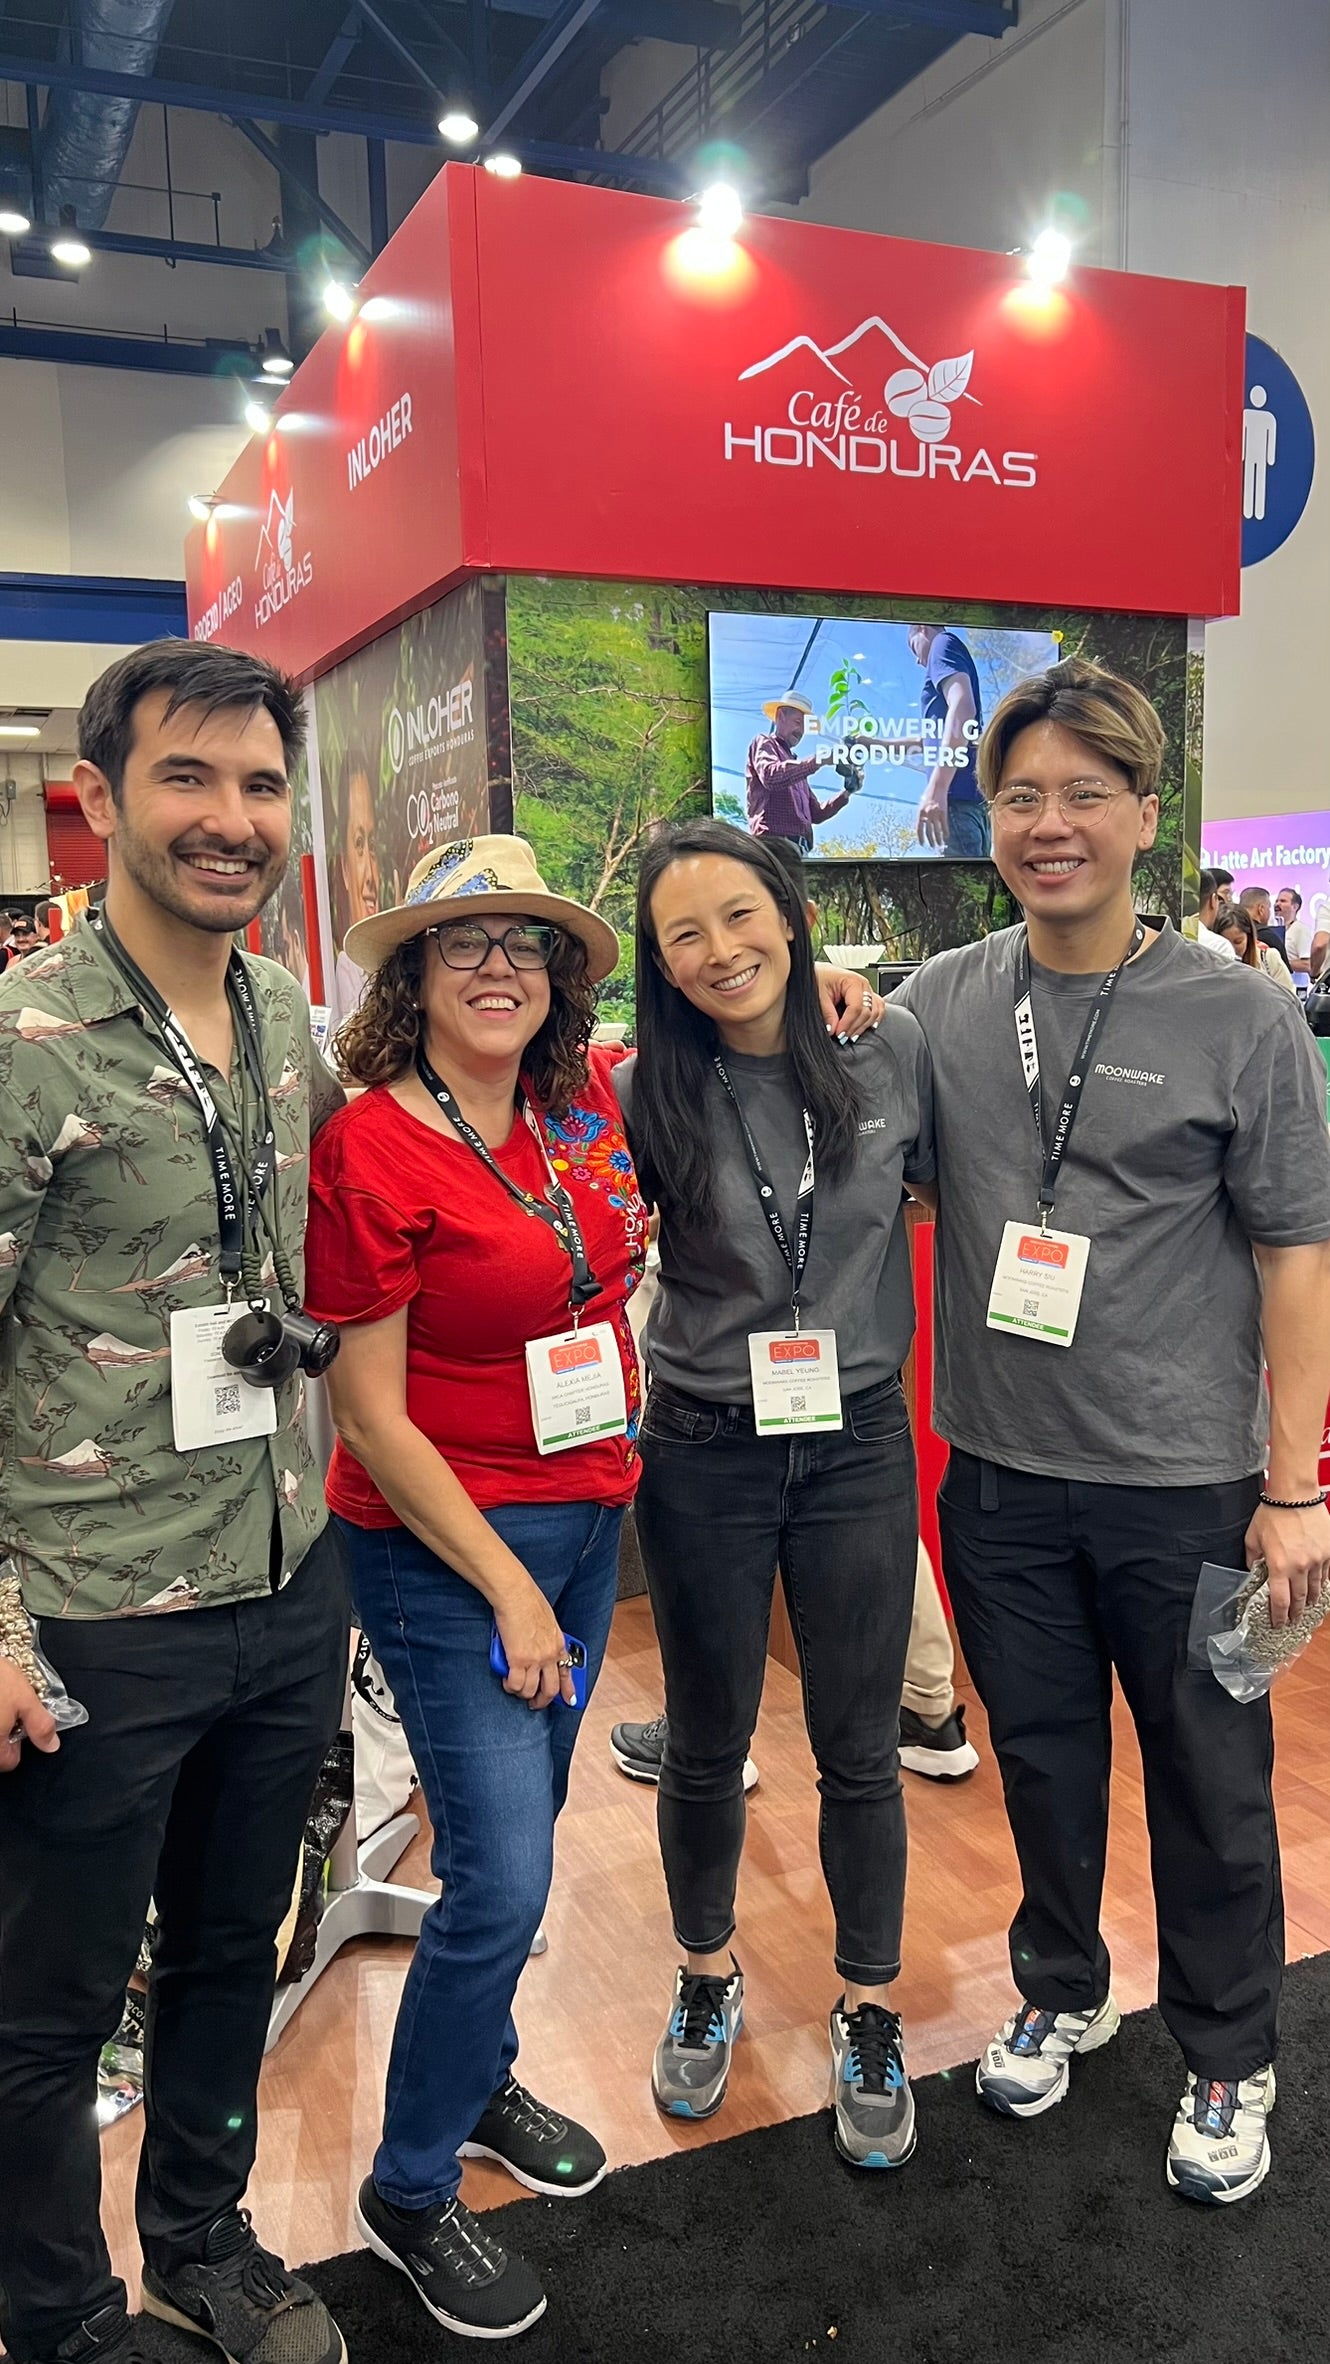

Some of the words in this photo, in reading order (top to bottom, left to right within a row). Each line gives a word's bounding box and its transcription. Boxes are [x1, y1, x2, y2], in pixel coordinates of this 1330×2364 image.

[788, 390, 862, 443] Café
[864, 411, 888, 433] de
[347, 392, 413, 491] INLOHER
[724, 422, 1037, 487] HONDURAS
[254, 551, 313, 629] HONDURAS
[406, 679, 473, 751] INLOHER
[803, 714, 979, 741] EMPOWERIG
[815, 743, 969, 767] PRODUCERS
[431, 788, 459, 812] Carbono
[433, 806, 459, 833] Neutral
[1213, 850, 1249, 869] Latte
[1250, 847, 1273, 868] Art
[1275, 844, 1330, 869] Factory
[1094, 1063, 1166, 1085] MOONWAKE
[858, 1118, 887, 1131] WAKE
[1022, 1243, 1064, 1263] EXPO
[1012, 1317, 1044, 1331] ATTENDEE
[553, 1345, 597, 1368] EXPO
[774, 1344, 816, 1359] EXPO
[567, 1424, 601, 1438] ATTENDEE
[783, 1415, 816, 1424] ATTENDEE
